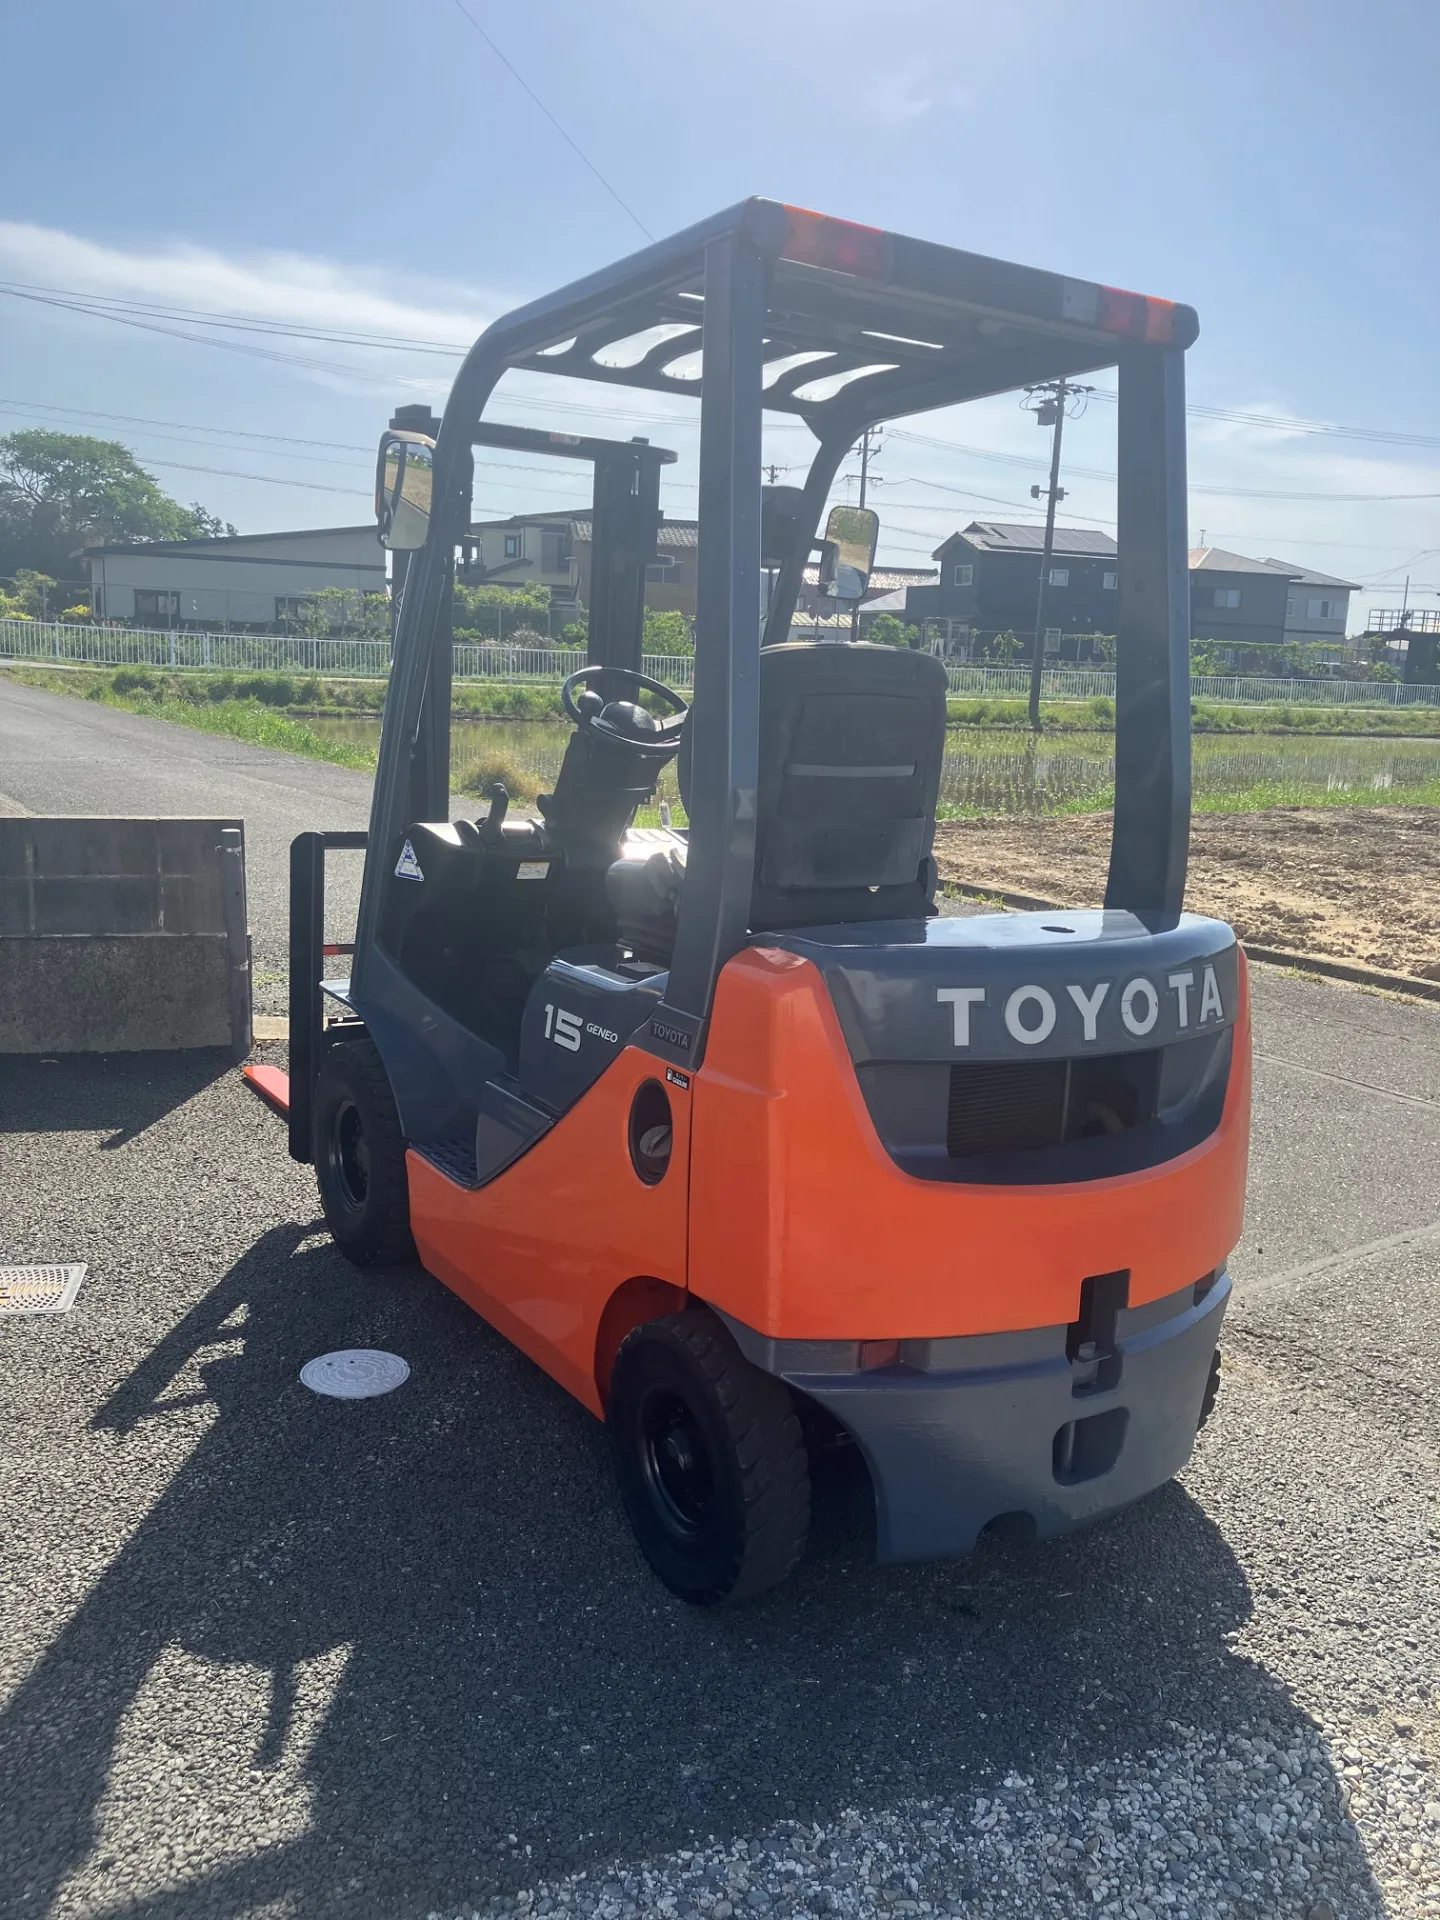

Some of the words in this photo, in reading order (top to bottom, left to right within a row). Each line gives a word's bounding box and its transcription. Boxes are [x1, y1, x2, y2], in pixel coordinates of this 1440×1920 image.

[544, 1004, 584, 1052] 15
[586, 1022, 619, 1043] GENEO
[936, 964, 1224, 1047] TOYOTA
[653, 1022, 689, 1048] TOYOTA
